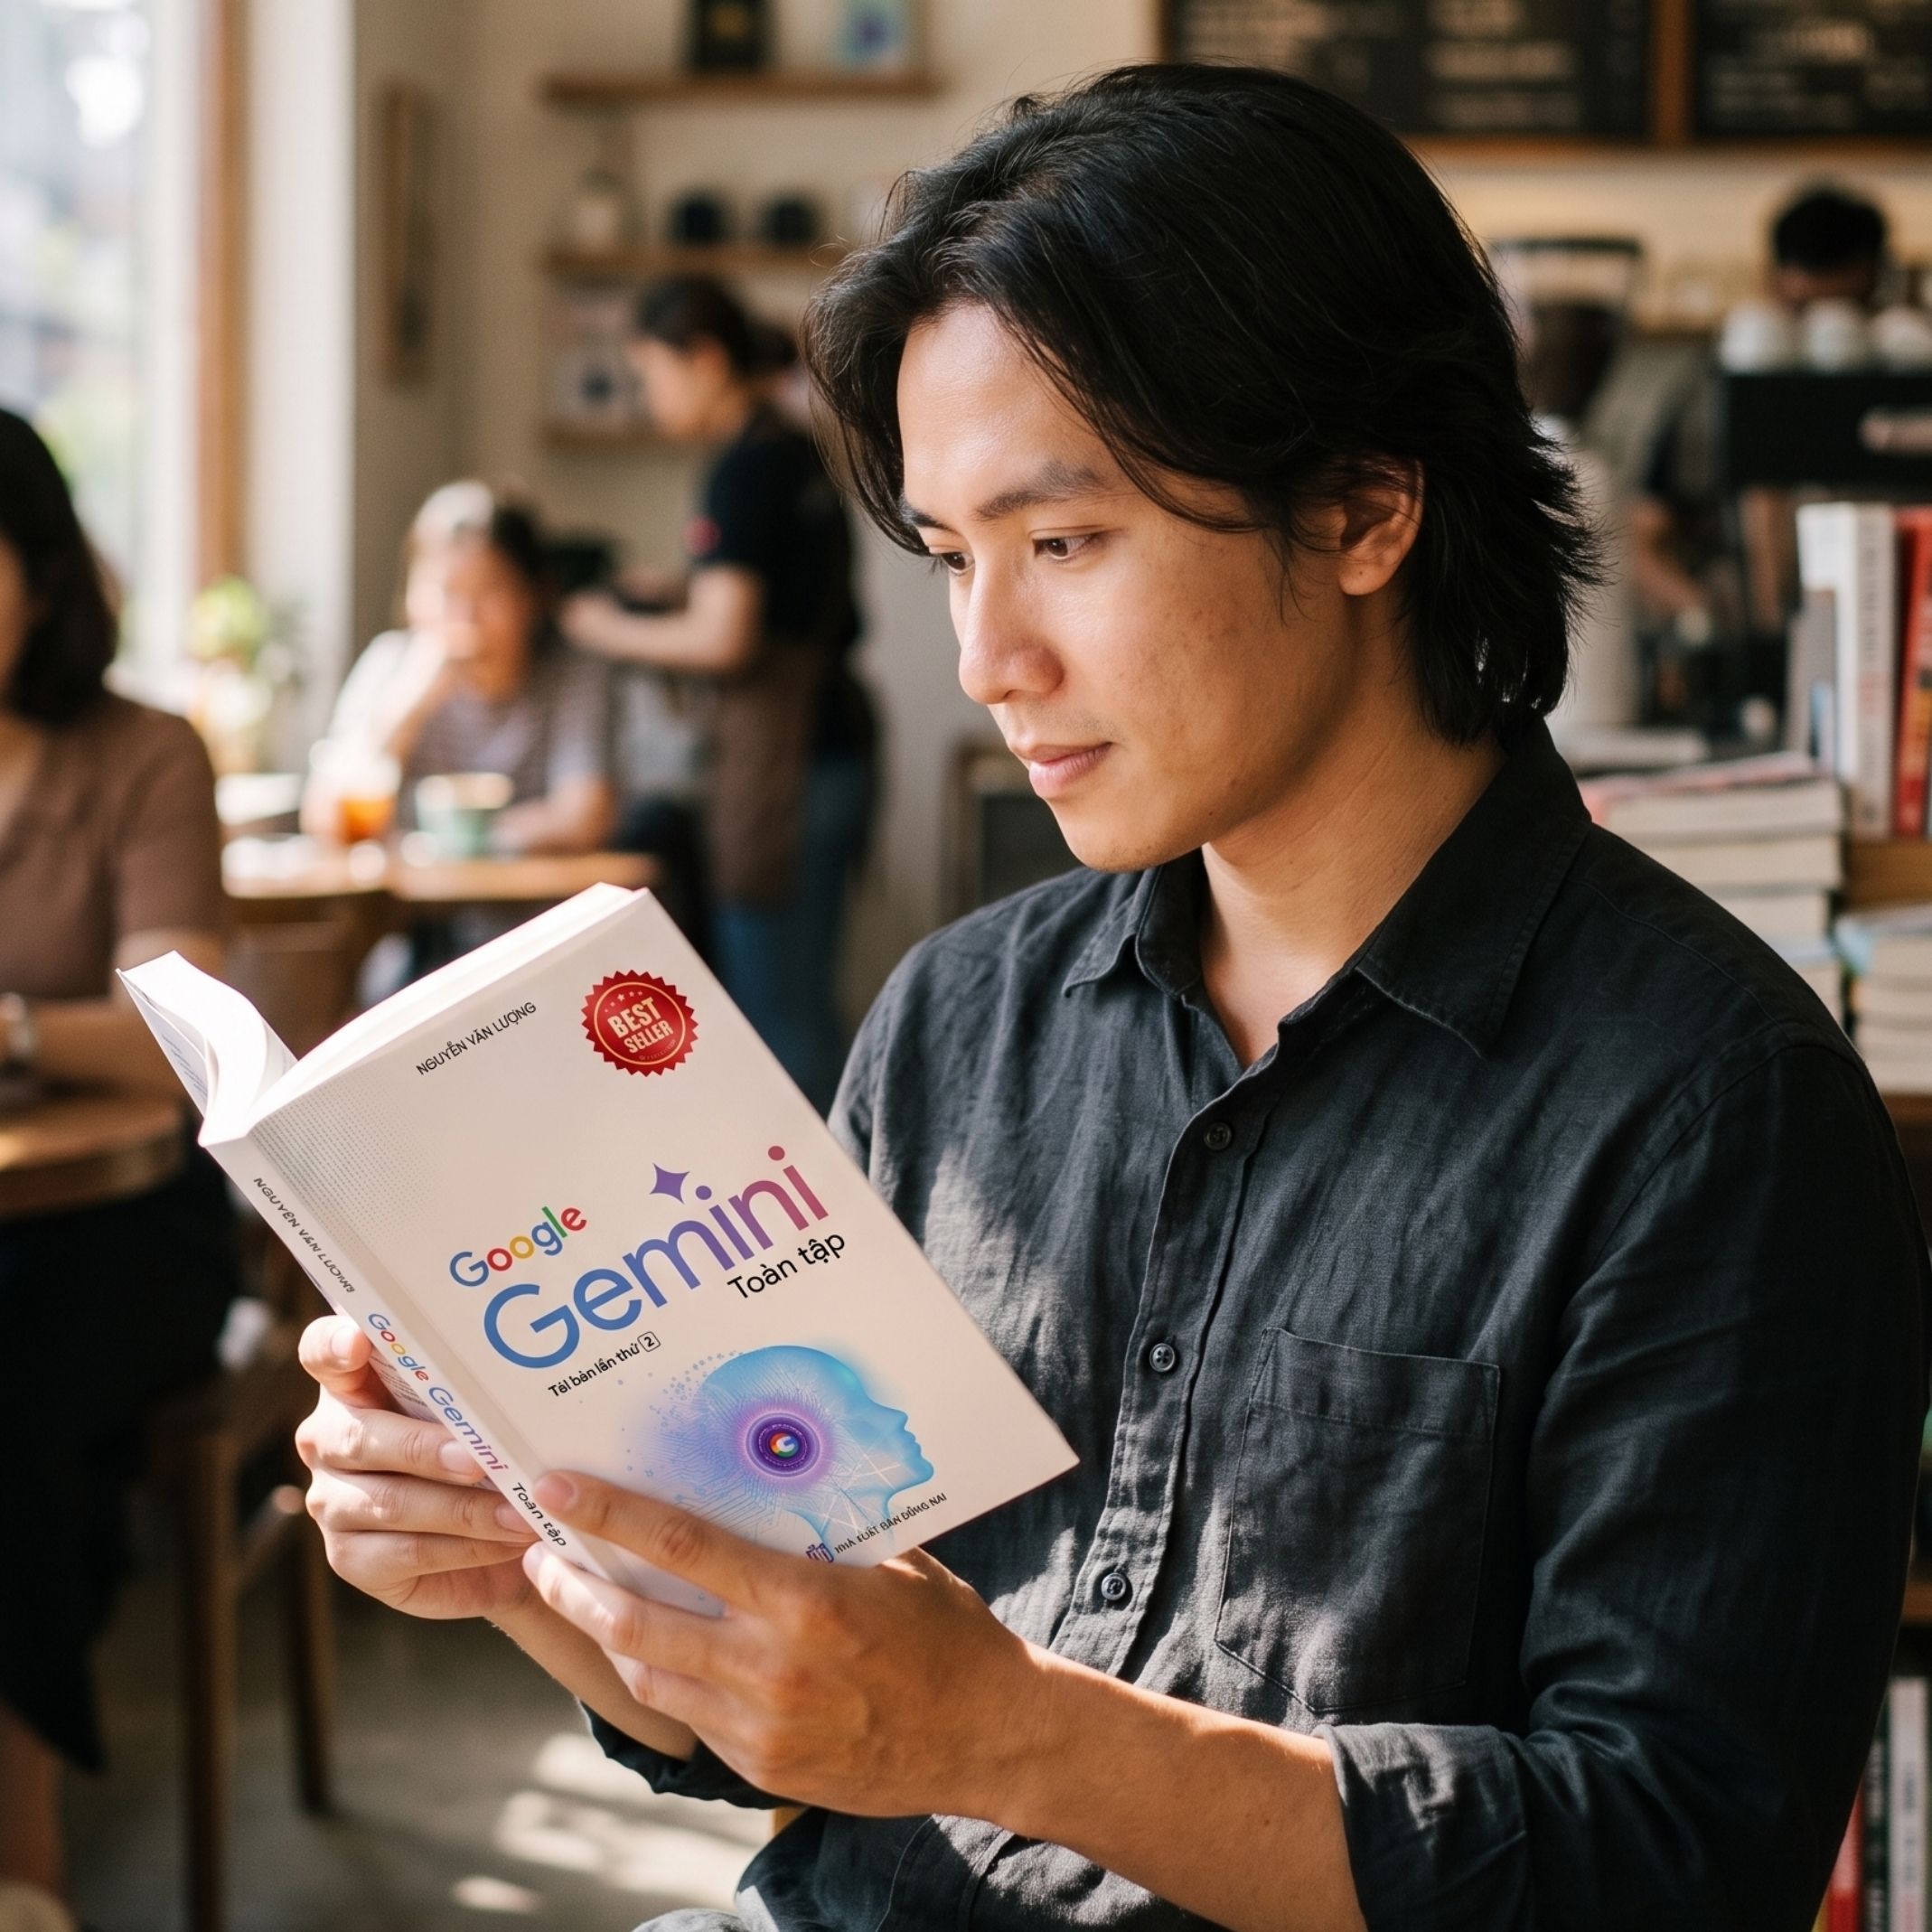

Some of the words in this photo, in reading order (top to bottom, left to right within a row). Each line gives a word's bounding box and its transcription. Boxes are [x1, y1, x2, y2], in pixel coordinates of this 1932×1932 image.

[607, 997, 661, 1038] BEST
[624, 1020, 674, 1054] SELLER
[449, 1205, 587, 1287] Google
[483, 1145, 829, 1369] Gemini
[727, 1263, 798, 1299] Toàn
[797, 1234, 845, 1265] tập
[368, 1313, 429, 1381] Google
[428, 1386, 509, 1473] Gemini
[929, 1492, 948, 1507] NAI
